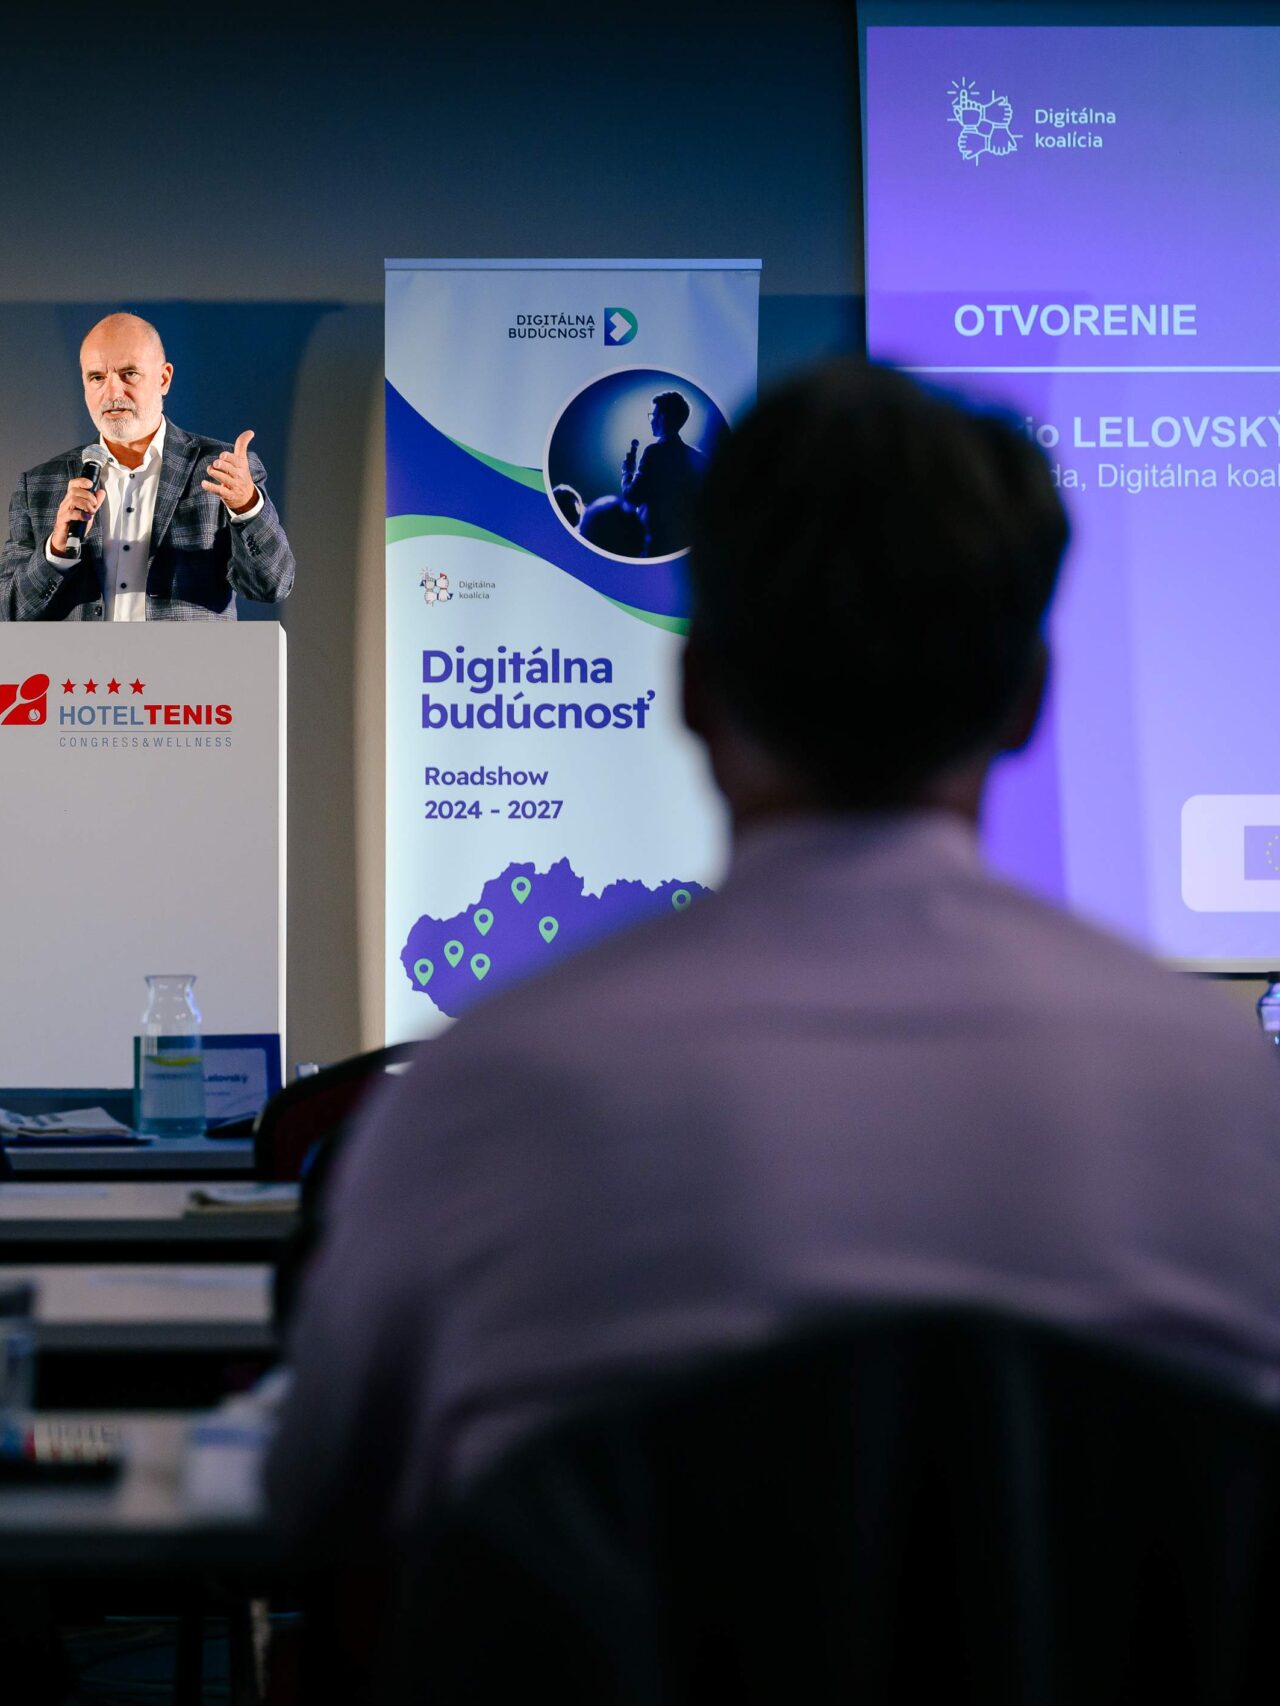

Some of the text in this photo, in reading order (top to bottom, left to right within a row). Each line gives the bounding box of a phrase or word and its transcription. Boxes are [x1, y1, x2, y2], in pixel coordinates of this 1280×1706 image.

[1034, 108, 1116, 128] Digitálna
[1034, 132, 1103, 149] koalícia
[516, 312, 596, 326] DIGITÁLNA
[954, 304, 1198, 337] OTVORENIE
[508, 325, 596, 339] BUDÚCNOSŤ
[1098, 463, 1217, 494] Digitálna
[459, 580, 496, 590] Digitálna
[422, 645, 614, 694] Digitálna
[421, 689, 656, 729] budúcnosť
[424, 766, 549, 786] Roadshow
[424, 800, 483, 820] 2024
[508, 800, 564, 820] 2027
